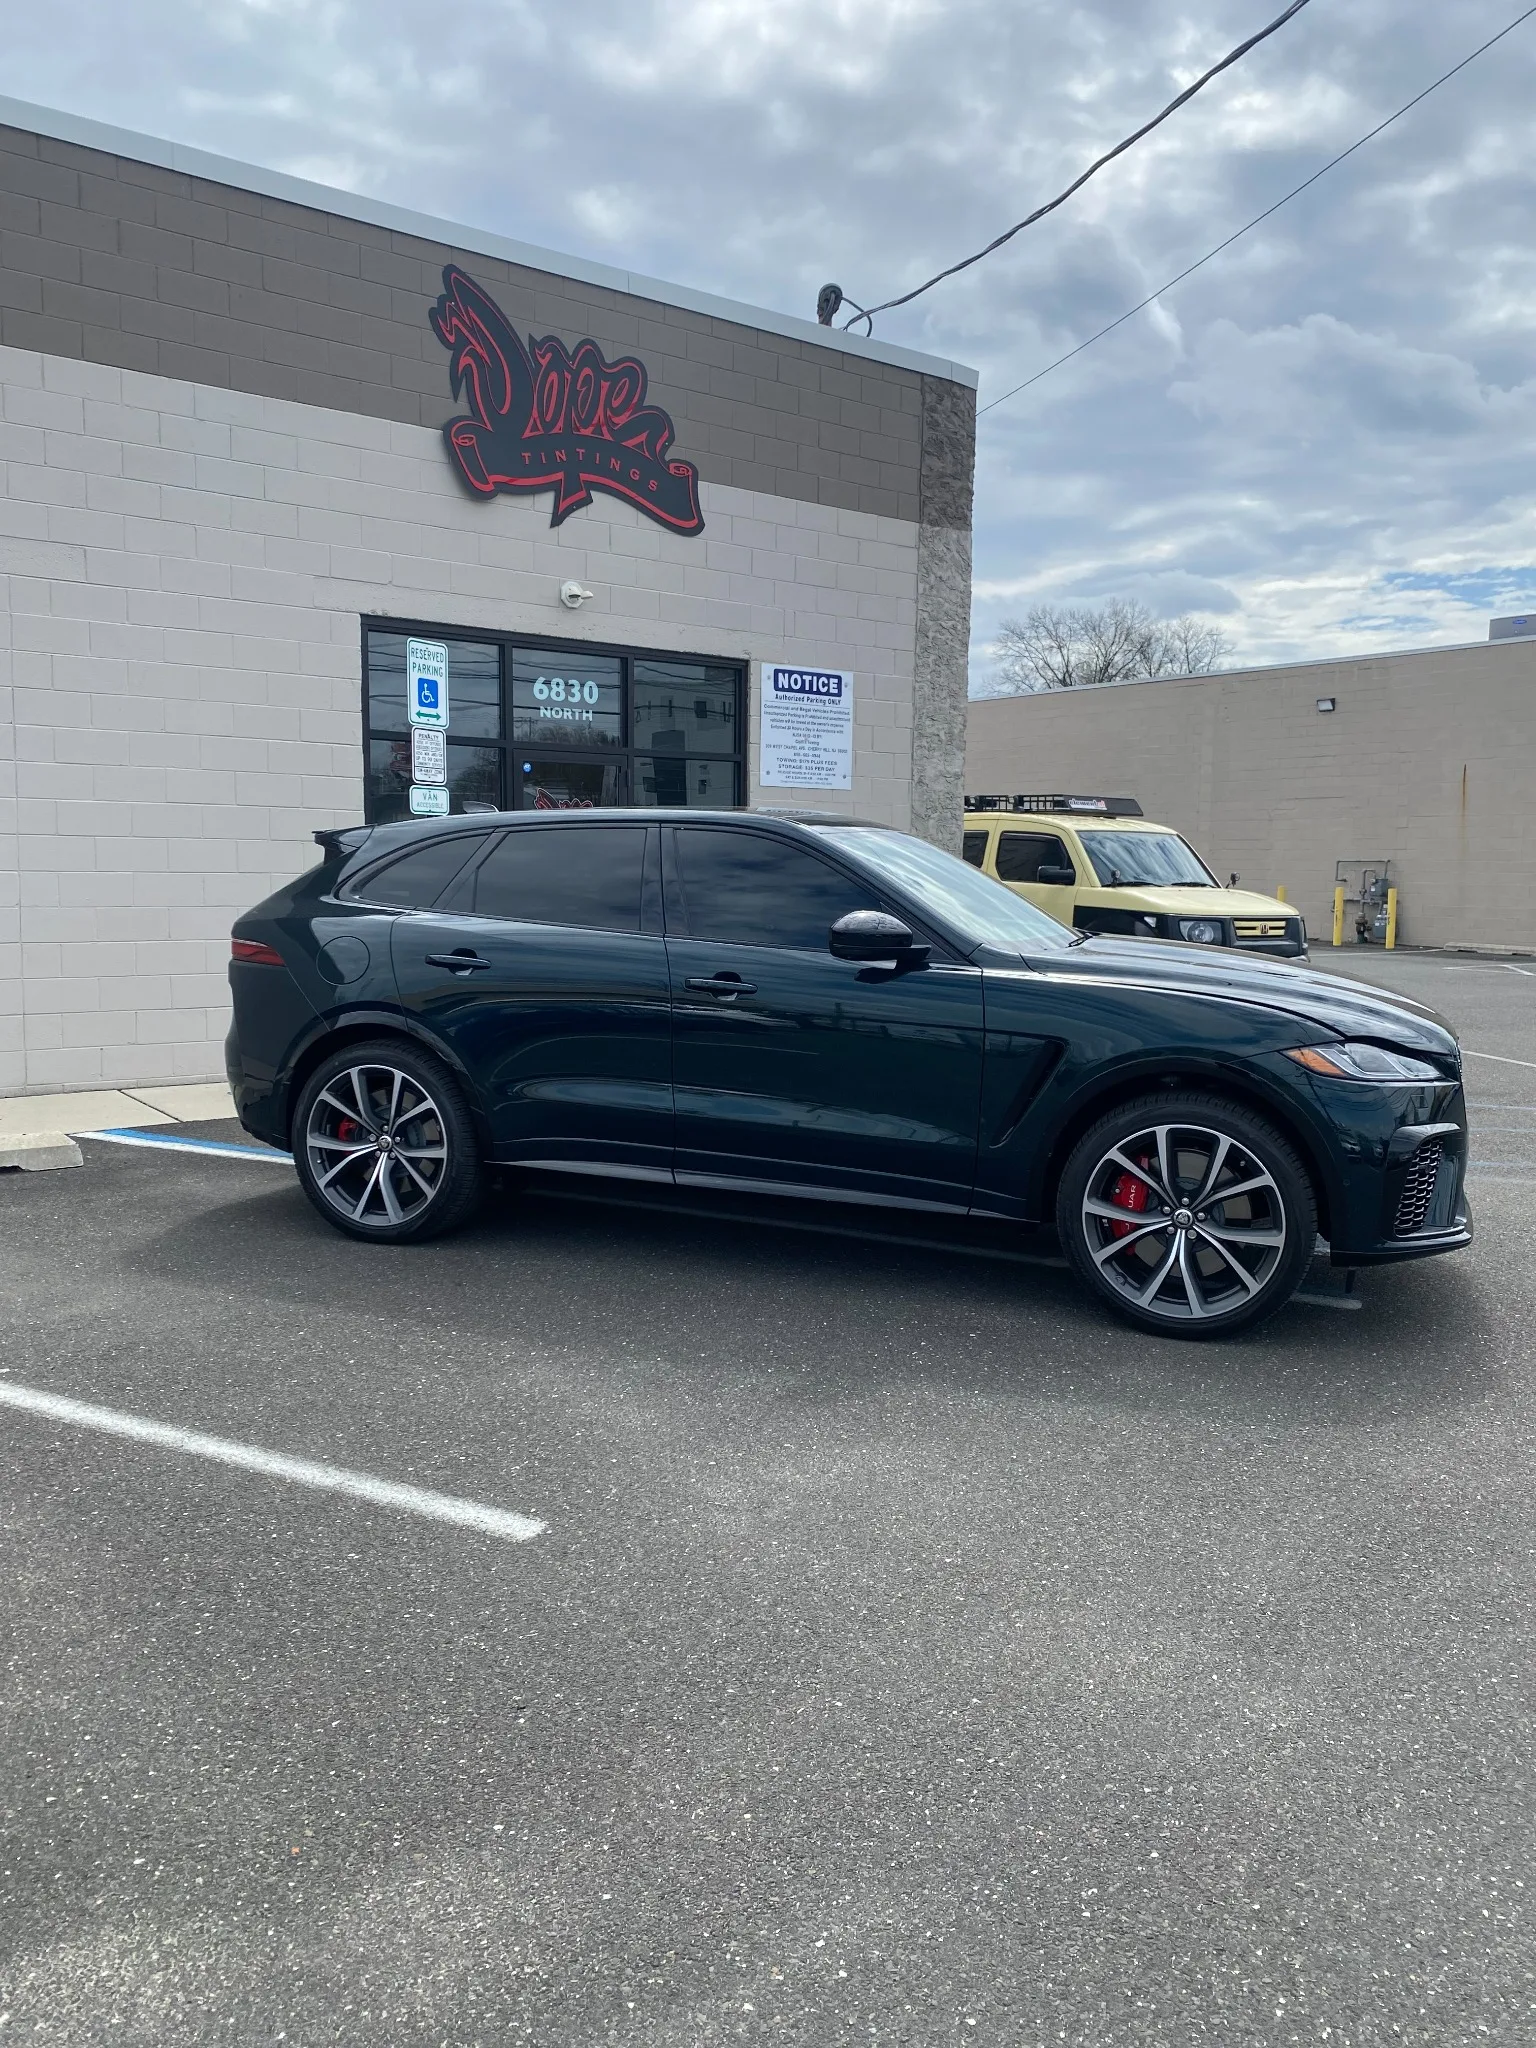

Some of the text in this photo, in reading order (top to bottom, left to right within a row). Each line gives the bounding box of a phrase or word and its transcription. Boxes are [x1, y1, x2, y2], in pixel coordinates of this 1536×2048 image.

[437, 273, 670, 460] Dope
[522, 448, 659, 492] TINTINGS
[411, 647, 444, 663] RESERVED
[412, 662, 443, 677] PARKING
[533, 676, 599, 705] 6830
[778, 672, 838, 693] NOTICE
[775, 693, 804, 702] Authorized
[806, 696, 826, 705] Parking
[540, 706, 593, 721] NORTH
[423, 792, 438, 801] VAN
